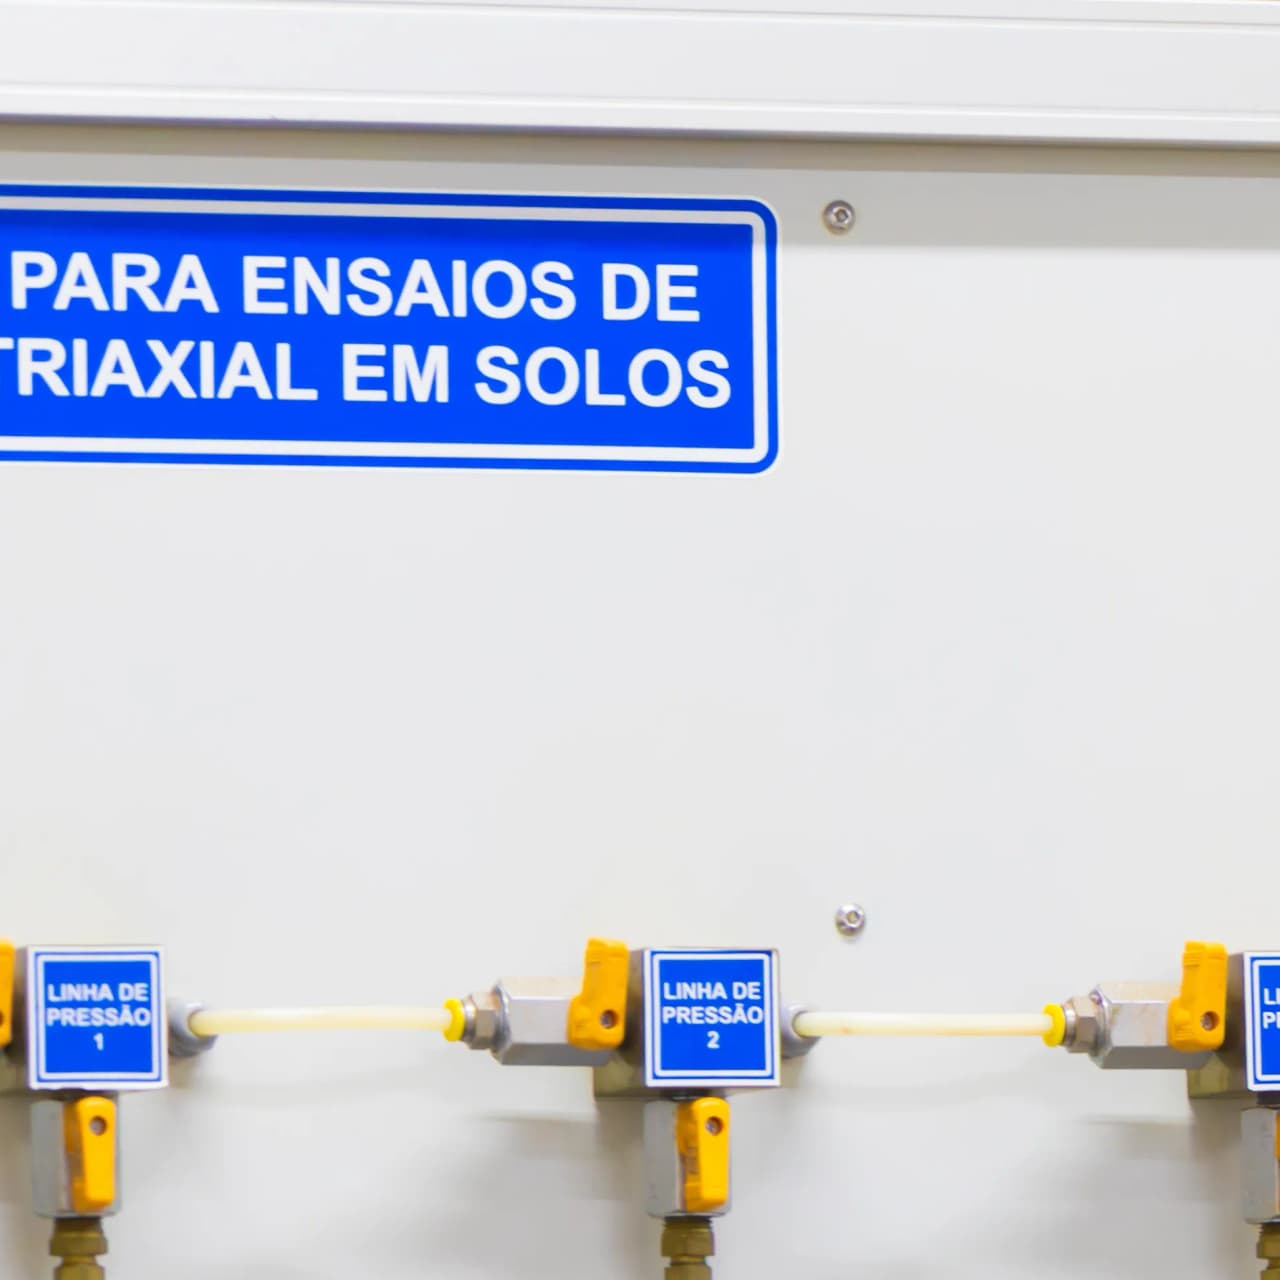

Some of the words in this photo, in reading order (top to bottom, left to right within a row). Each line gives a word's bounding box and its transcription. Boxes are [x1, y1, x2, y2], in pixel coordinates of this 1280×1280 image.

[11, 250, 220, 313] PARA
[242, 255, 577, 320] ENSAIOS
[602, 262, 700, 322] DE
[342, 343, 449, 403] EM
[474, 345, 731, 409] SOLOS
[47, 983, 114, 1002] LINHA
[117, 982, 149, 1002] DE
[663, 981, 728, 1000] LINHA
[732, 981, 761, 1000] DE
[46, 1004, 151, 1027] PRESSÃO
[662, 1003, 763, 1025] PRESSÃO
[92, 1032, 104, 1051] 1
[706, 1030, 720, 1049] 2
